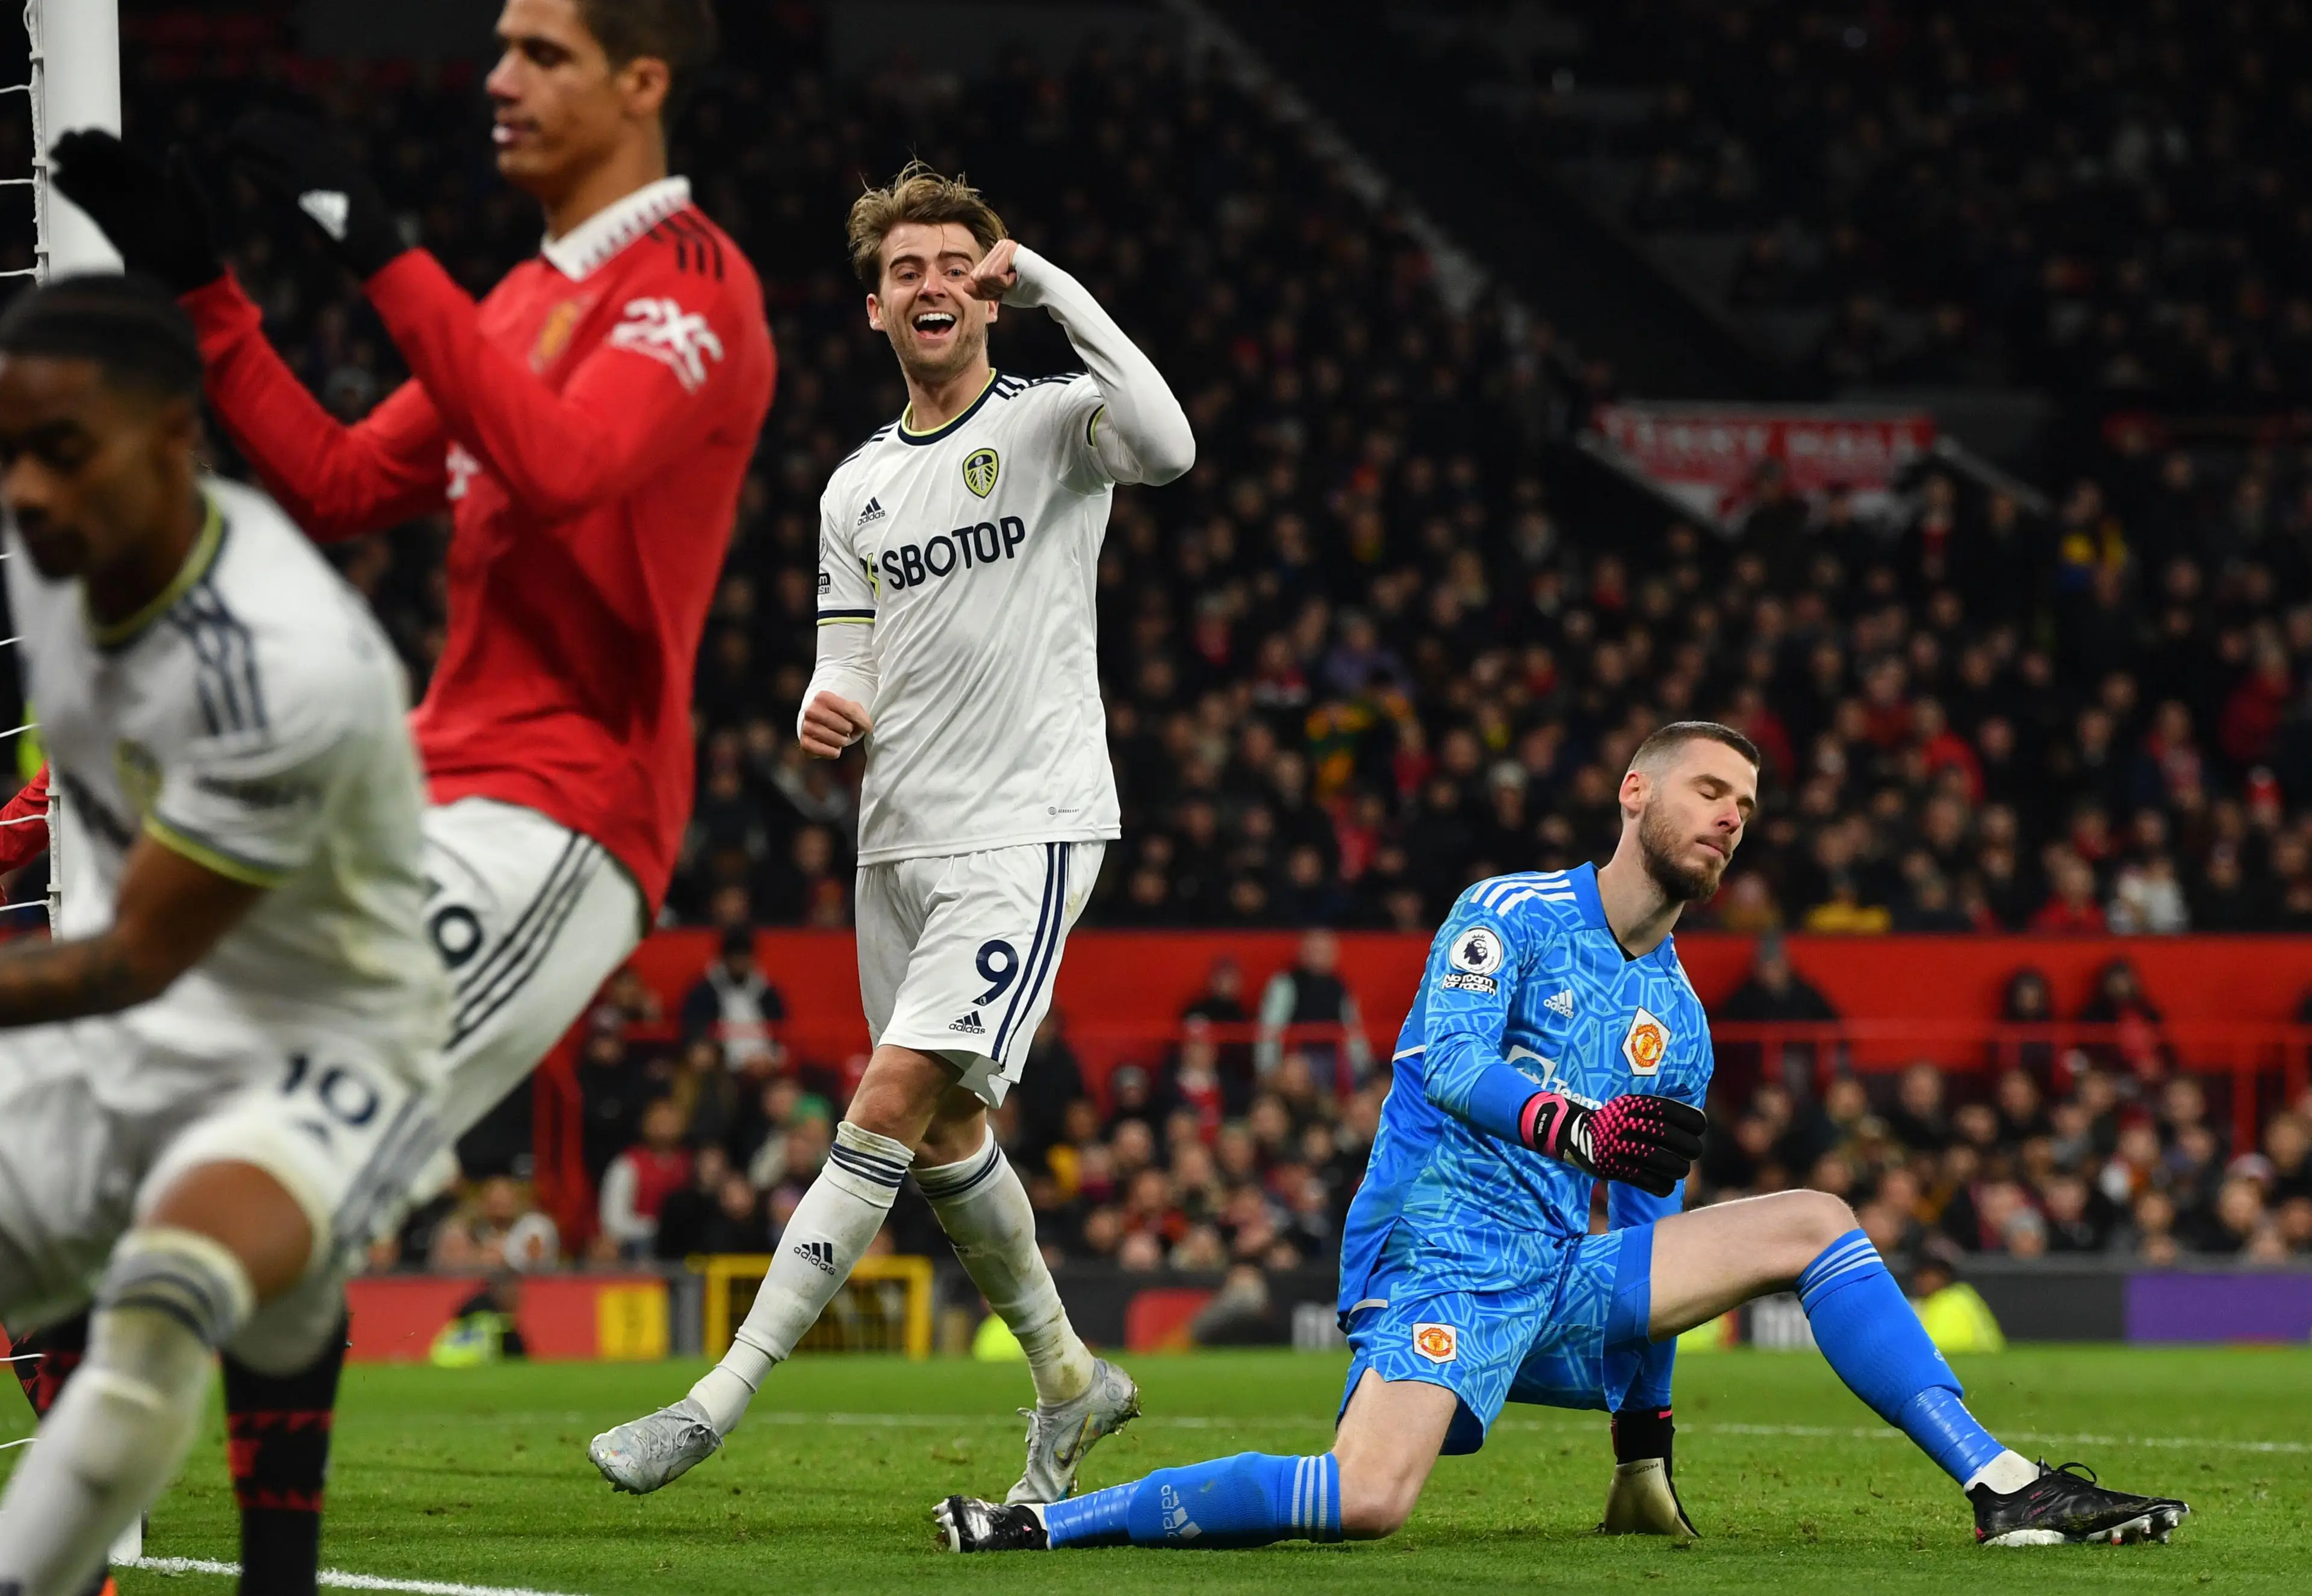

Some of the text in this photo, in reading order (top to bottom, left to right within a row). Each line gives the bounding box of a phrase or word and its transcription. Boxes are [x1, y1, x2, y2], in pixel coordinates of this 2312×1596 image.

[857, 510, 885, 526] adidas
[882, 516, 1025, 590] SBOTOP
[971, 940, 1019, 1006] 9
[1462, 974, 1493, 987] room
[1459, 983, 1496, 996] racism
[1543, 999, 1574, 1019] adidas
[949, 1023, 986, 1034] adidas
[282, 1051, 381, 1127] 10
[794, 1246, 836, 1275] adidas
[1161, 1484, 1178, 1537] adid
